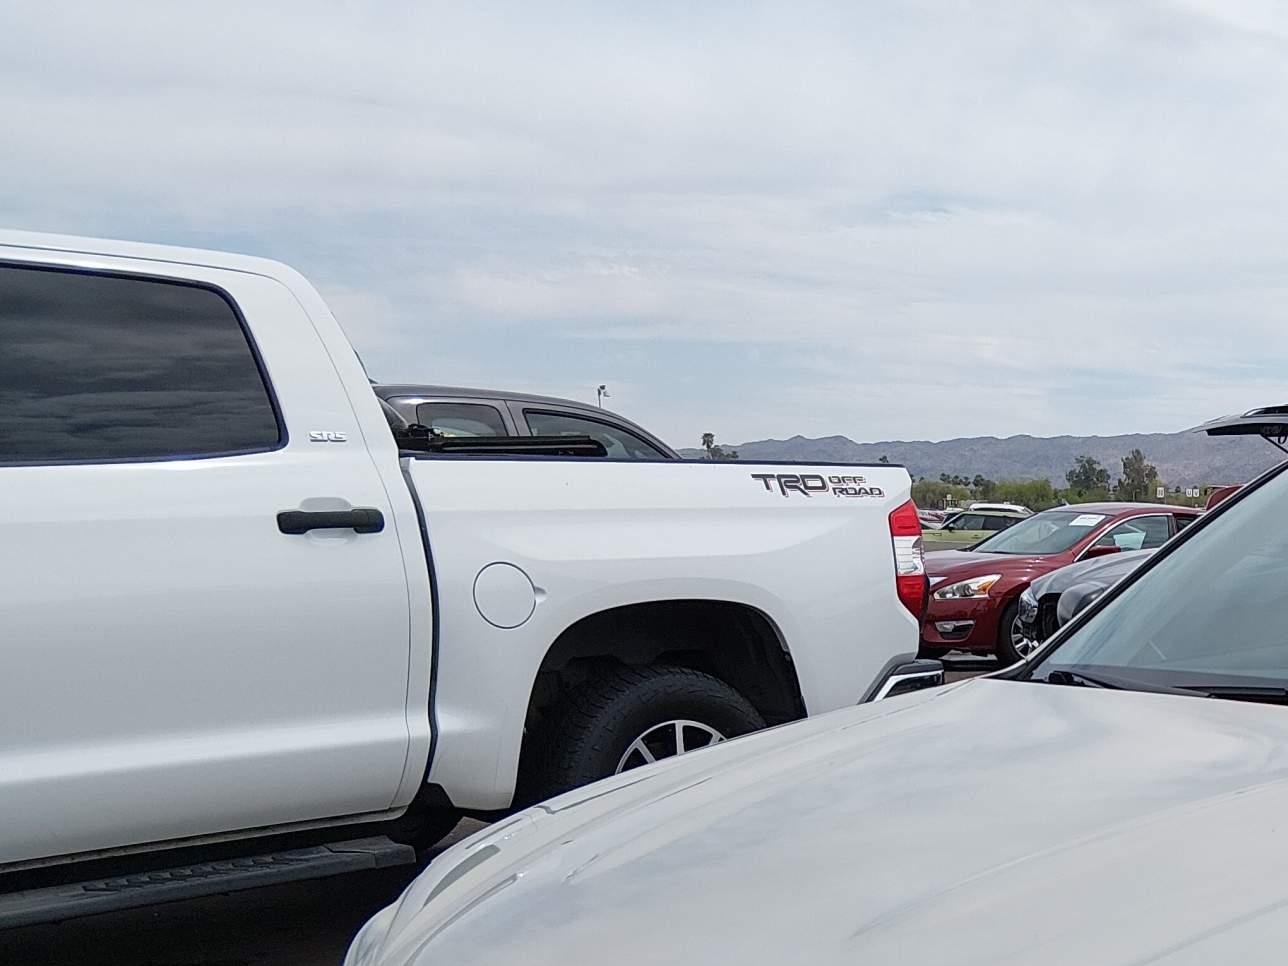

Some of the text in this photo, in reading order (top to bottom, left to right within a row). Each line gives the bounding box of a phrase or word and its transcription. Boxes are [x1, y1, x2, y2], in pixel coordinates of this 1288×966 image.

[751, 473, 866, 497] TRD OFF
[832, 486, 885, 498] ROAD
